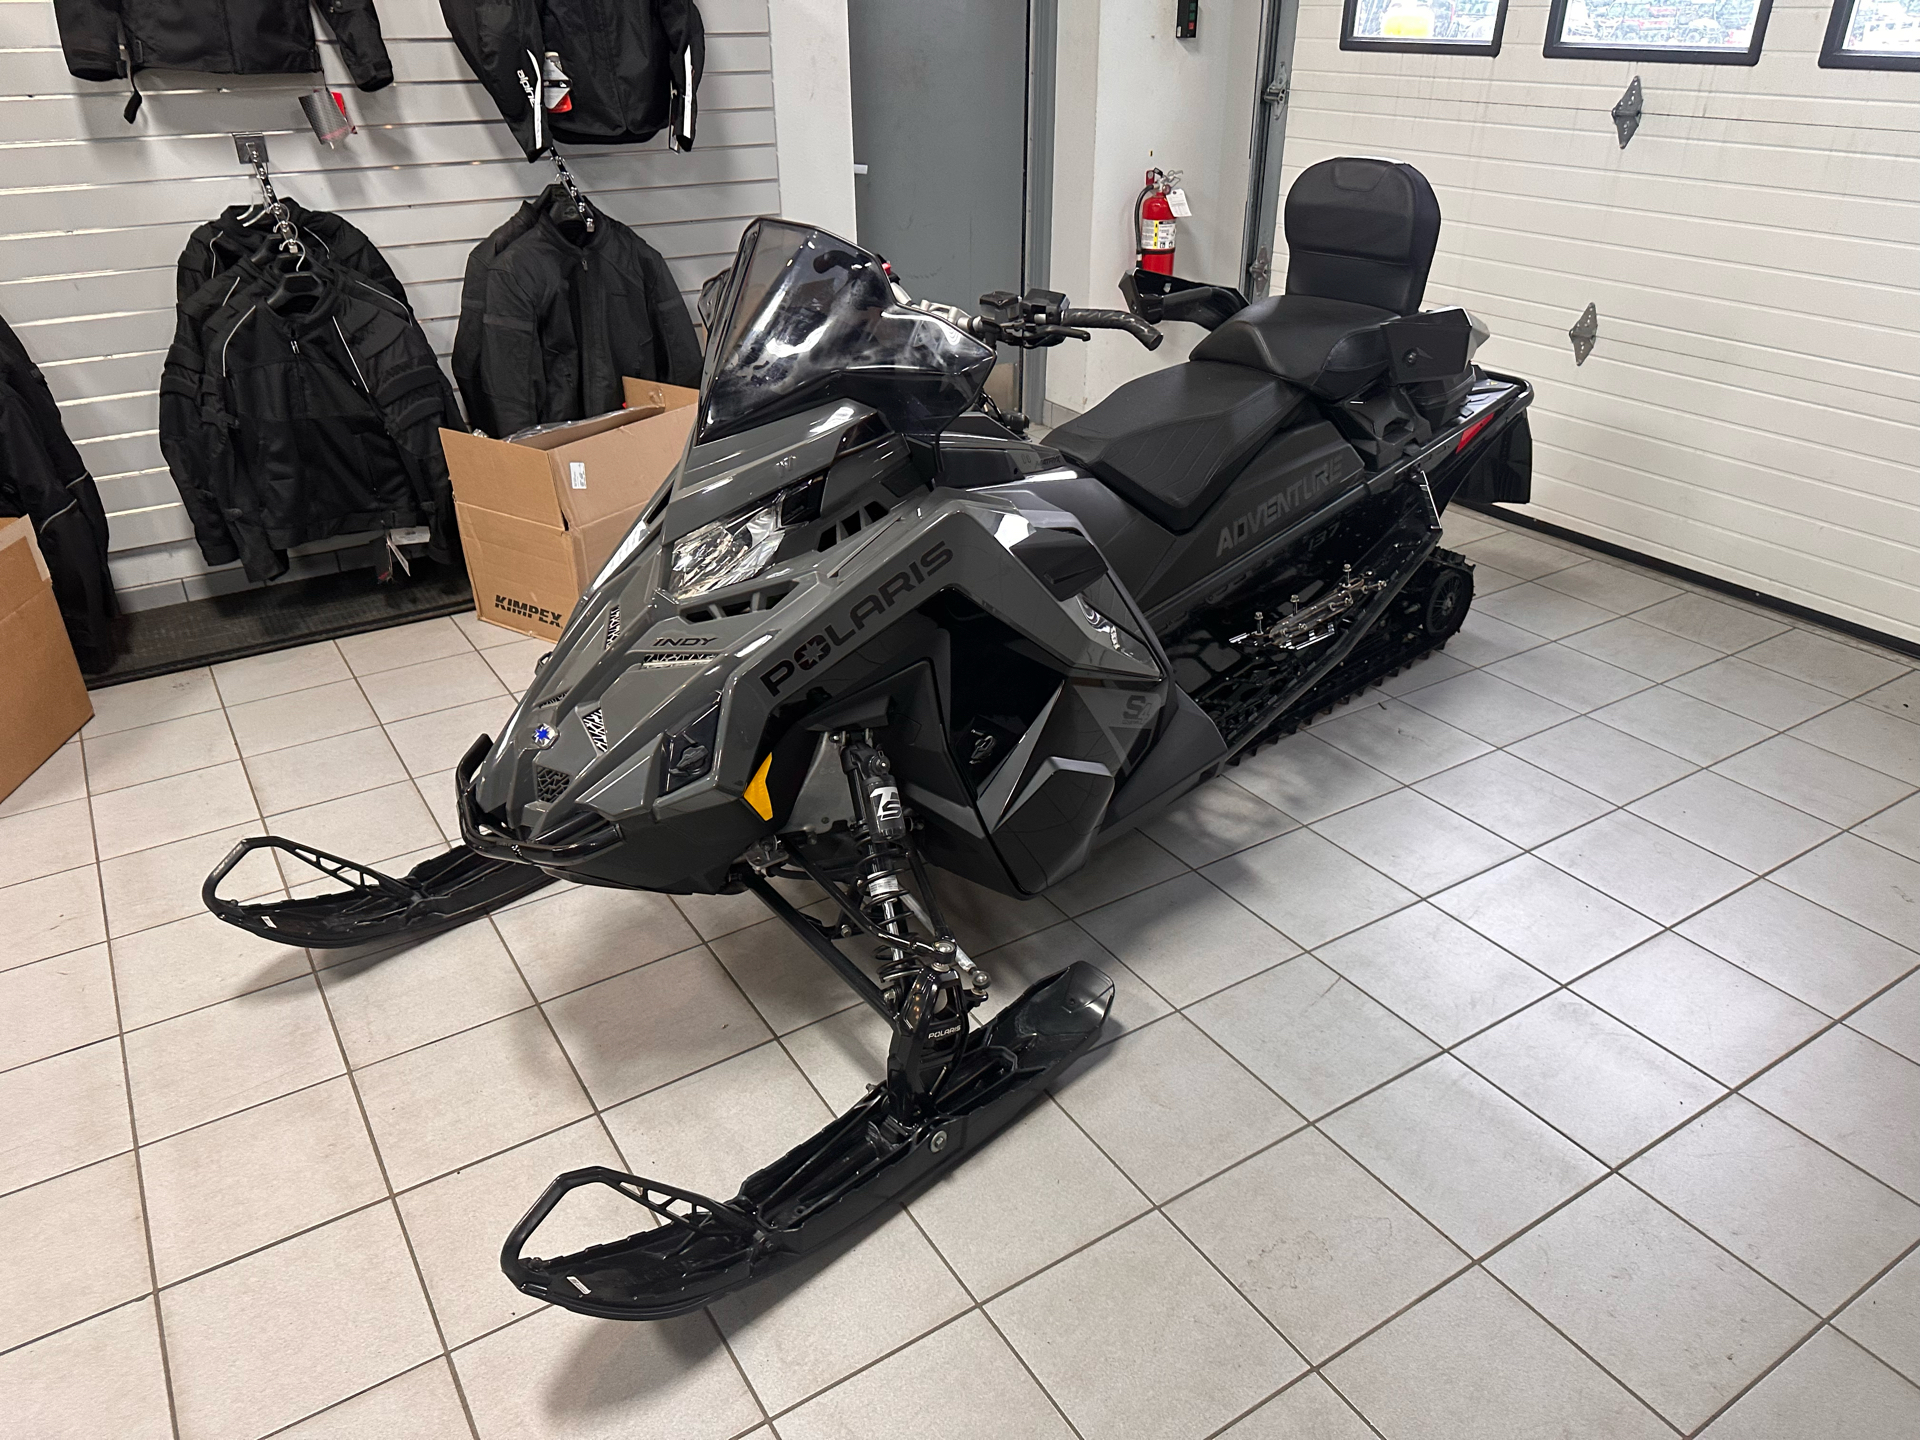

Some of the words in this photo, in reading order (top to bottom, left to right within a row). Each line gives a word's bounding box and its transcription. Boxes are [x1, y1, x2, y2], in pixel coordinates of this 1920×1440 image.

[1216, 453, 1343, 557] ADVENTURE
[495, 594, 562, 628] KIMPEX
[759, 541, 954, 698] POLARIS
[652, 637, 717, 647] INDY
[928, 1025, 961, 1039] POLARIS
